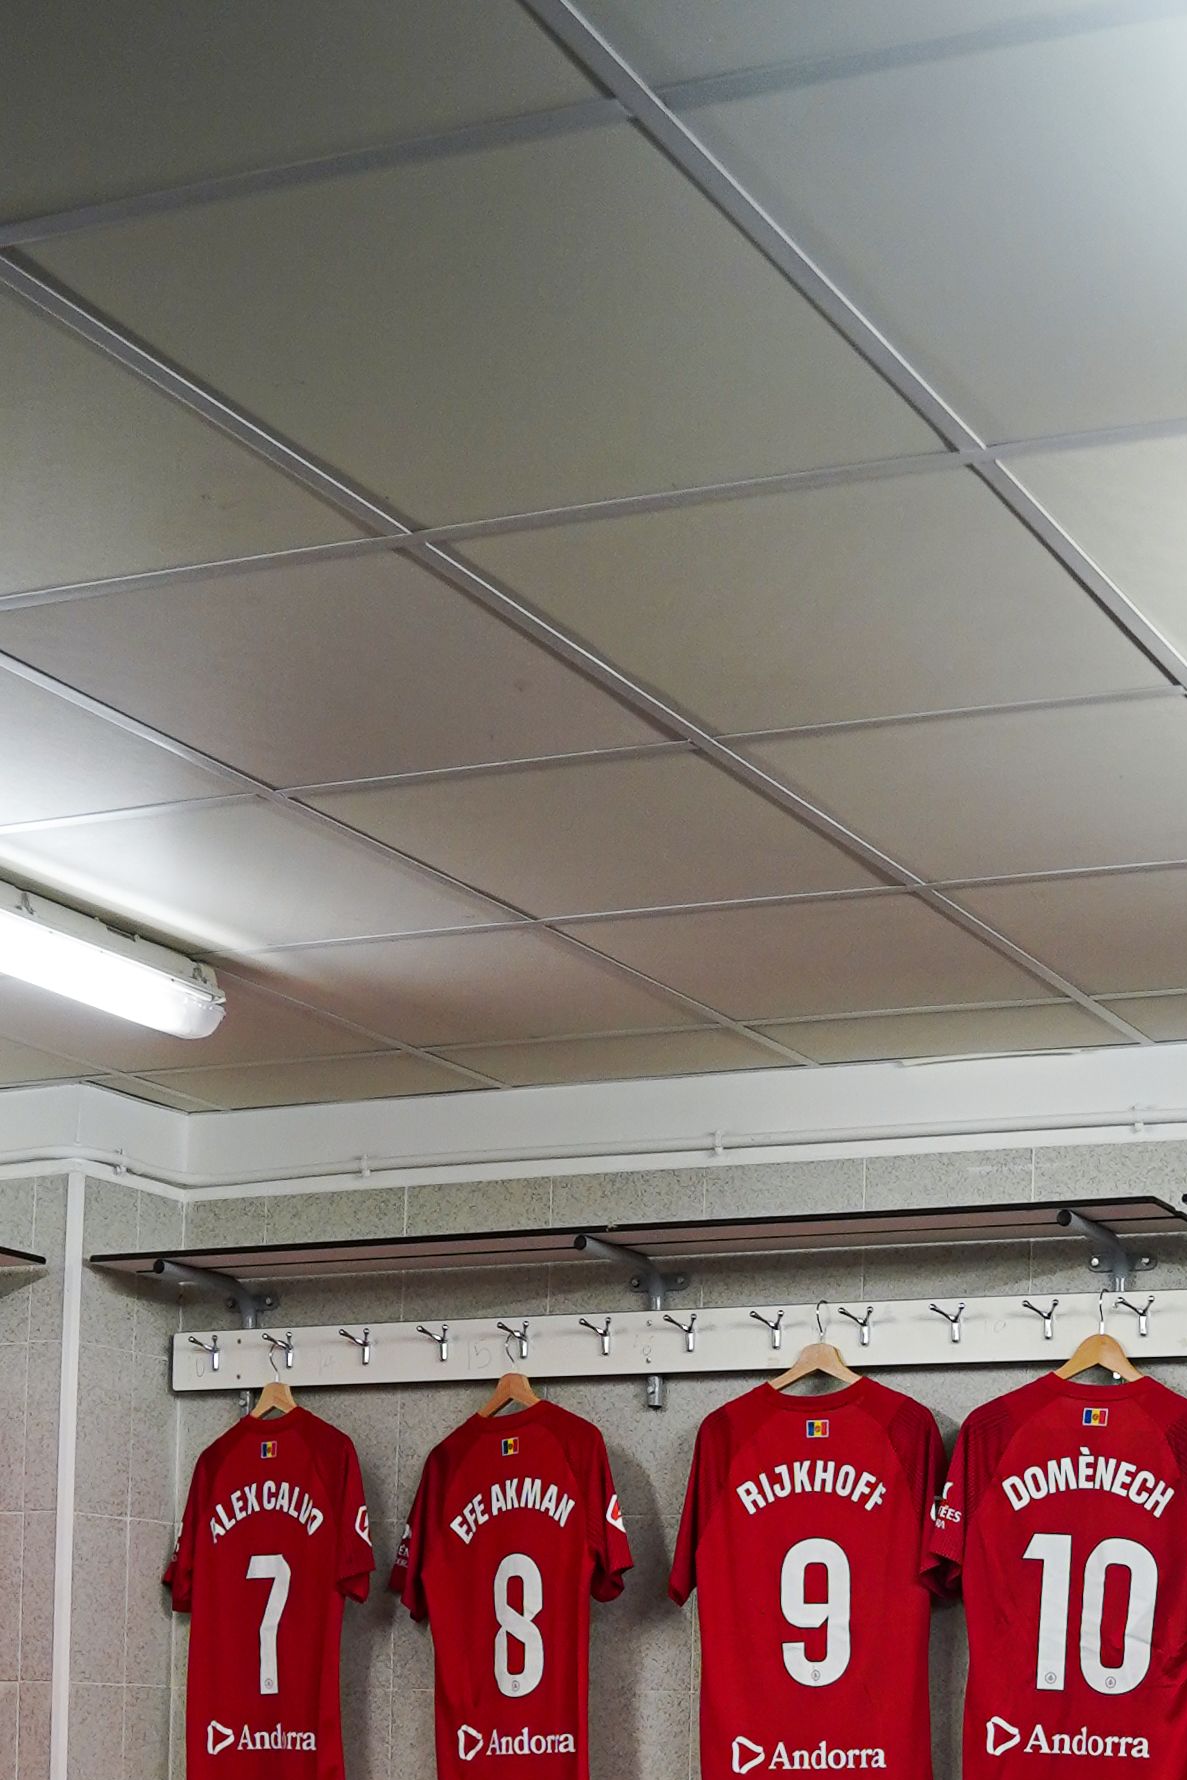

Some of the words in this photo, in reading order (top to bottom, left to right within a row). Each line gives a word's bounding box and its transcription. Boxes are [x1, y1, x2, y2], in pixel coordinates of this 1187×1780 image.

[450, 1494, 489, 1544] EFE
[491, 1478, 575, 1527] AKMAN
[737, 1460, 886, 1512] RIJKHOFF
[1002, 1447, 1174, 1517] DOMÈNECH
[246, 1554, 291, 1694] 7
[494, 1554, 544, 1697] 8
[781, 1538, 850, 1686] 9
[1023, 1534, 1158, 1694] 10
[486, 1727, 575, 1755] Andorra
[769, 1741, 886, 1769] Andorra
[1024, 1724, 1149, 1758] Andorra
